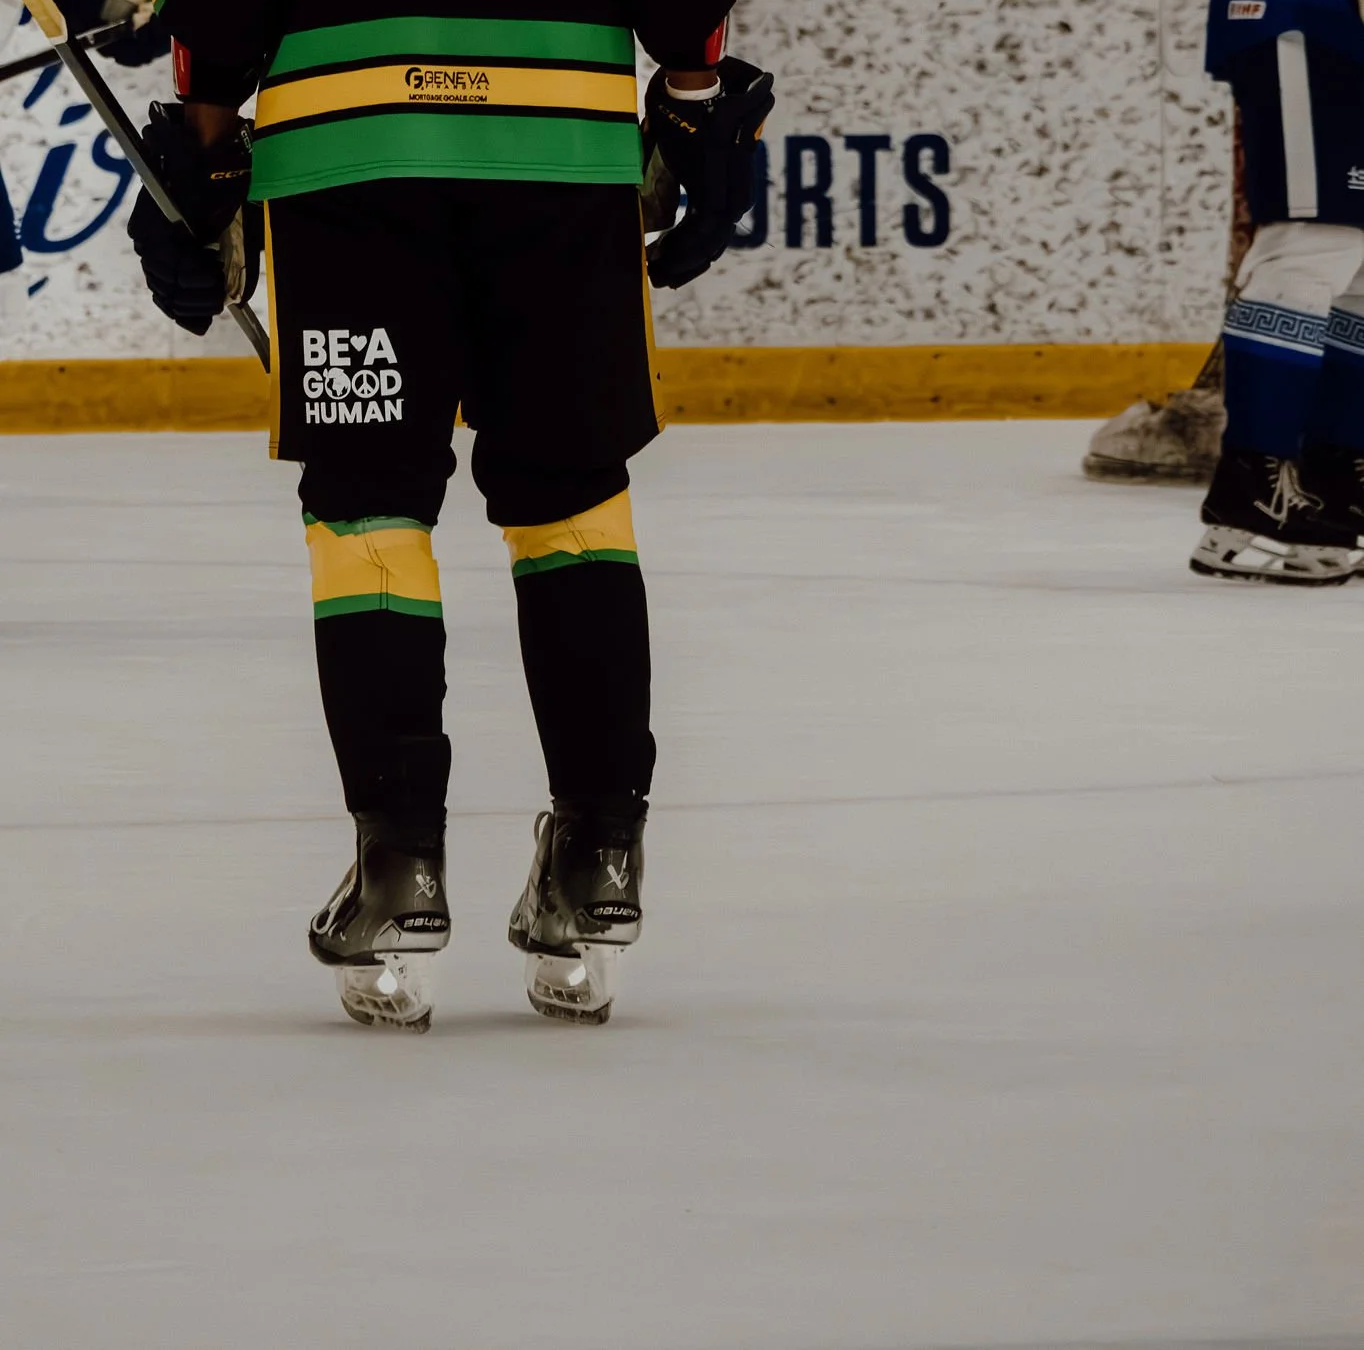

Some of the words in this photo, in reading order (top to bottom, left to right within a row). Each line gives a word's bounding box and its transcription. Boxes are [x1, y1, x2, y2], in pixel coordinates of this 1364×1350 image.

[424, 70, 490, 86] GENEVA
[302, 329, 351, 367] BE
[363, 327, 398, 366] A
[305, 400, 403, 424] HUMAN
